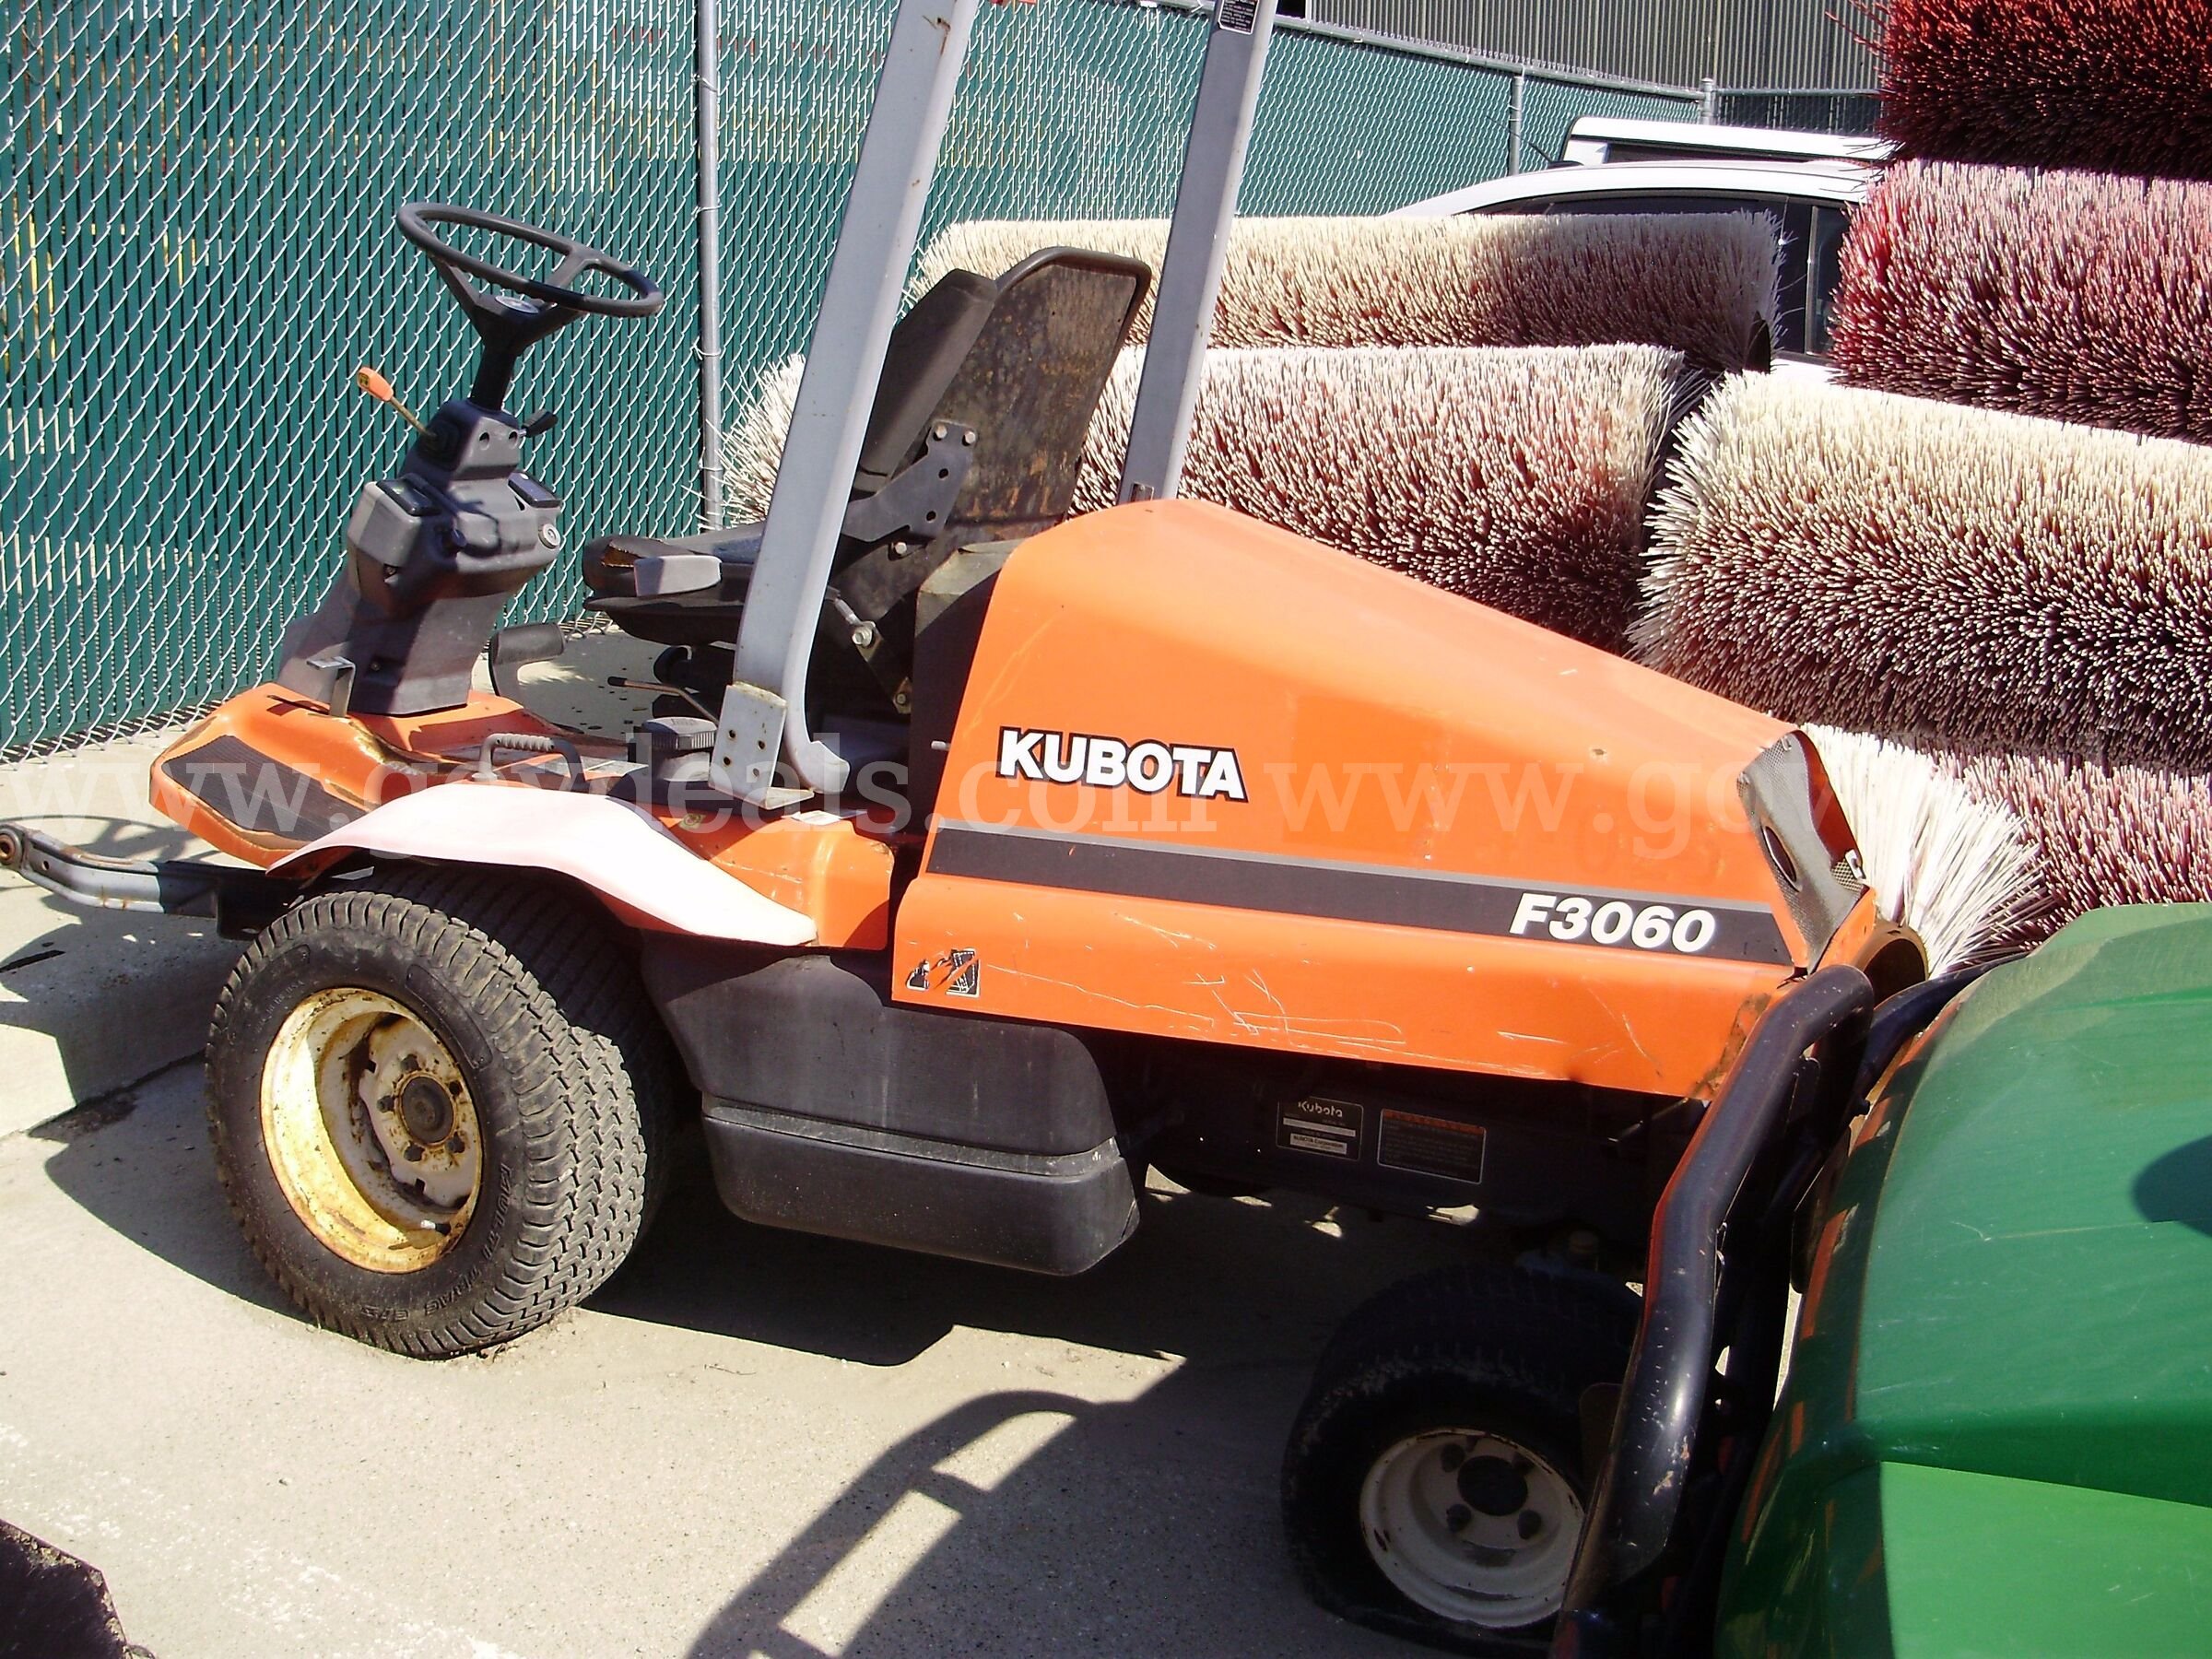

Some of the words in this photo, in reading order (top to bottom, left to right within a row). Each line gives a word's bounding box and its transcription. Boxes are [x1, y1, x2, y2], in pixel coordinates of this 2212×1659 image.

[998, 727, 1247, 802] KUBOTA
[1509, 892, 1715, 953] F3060
[1298, 1100, 1344, 1118] Kubota
